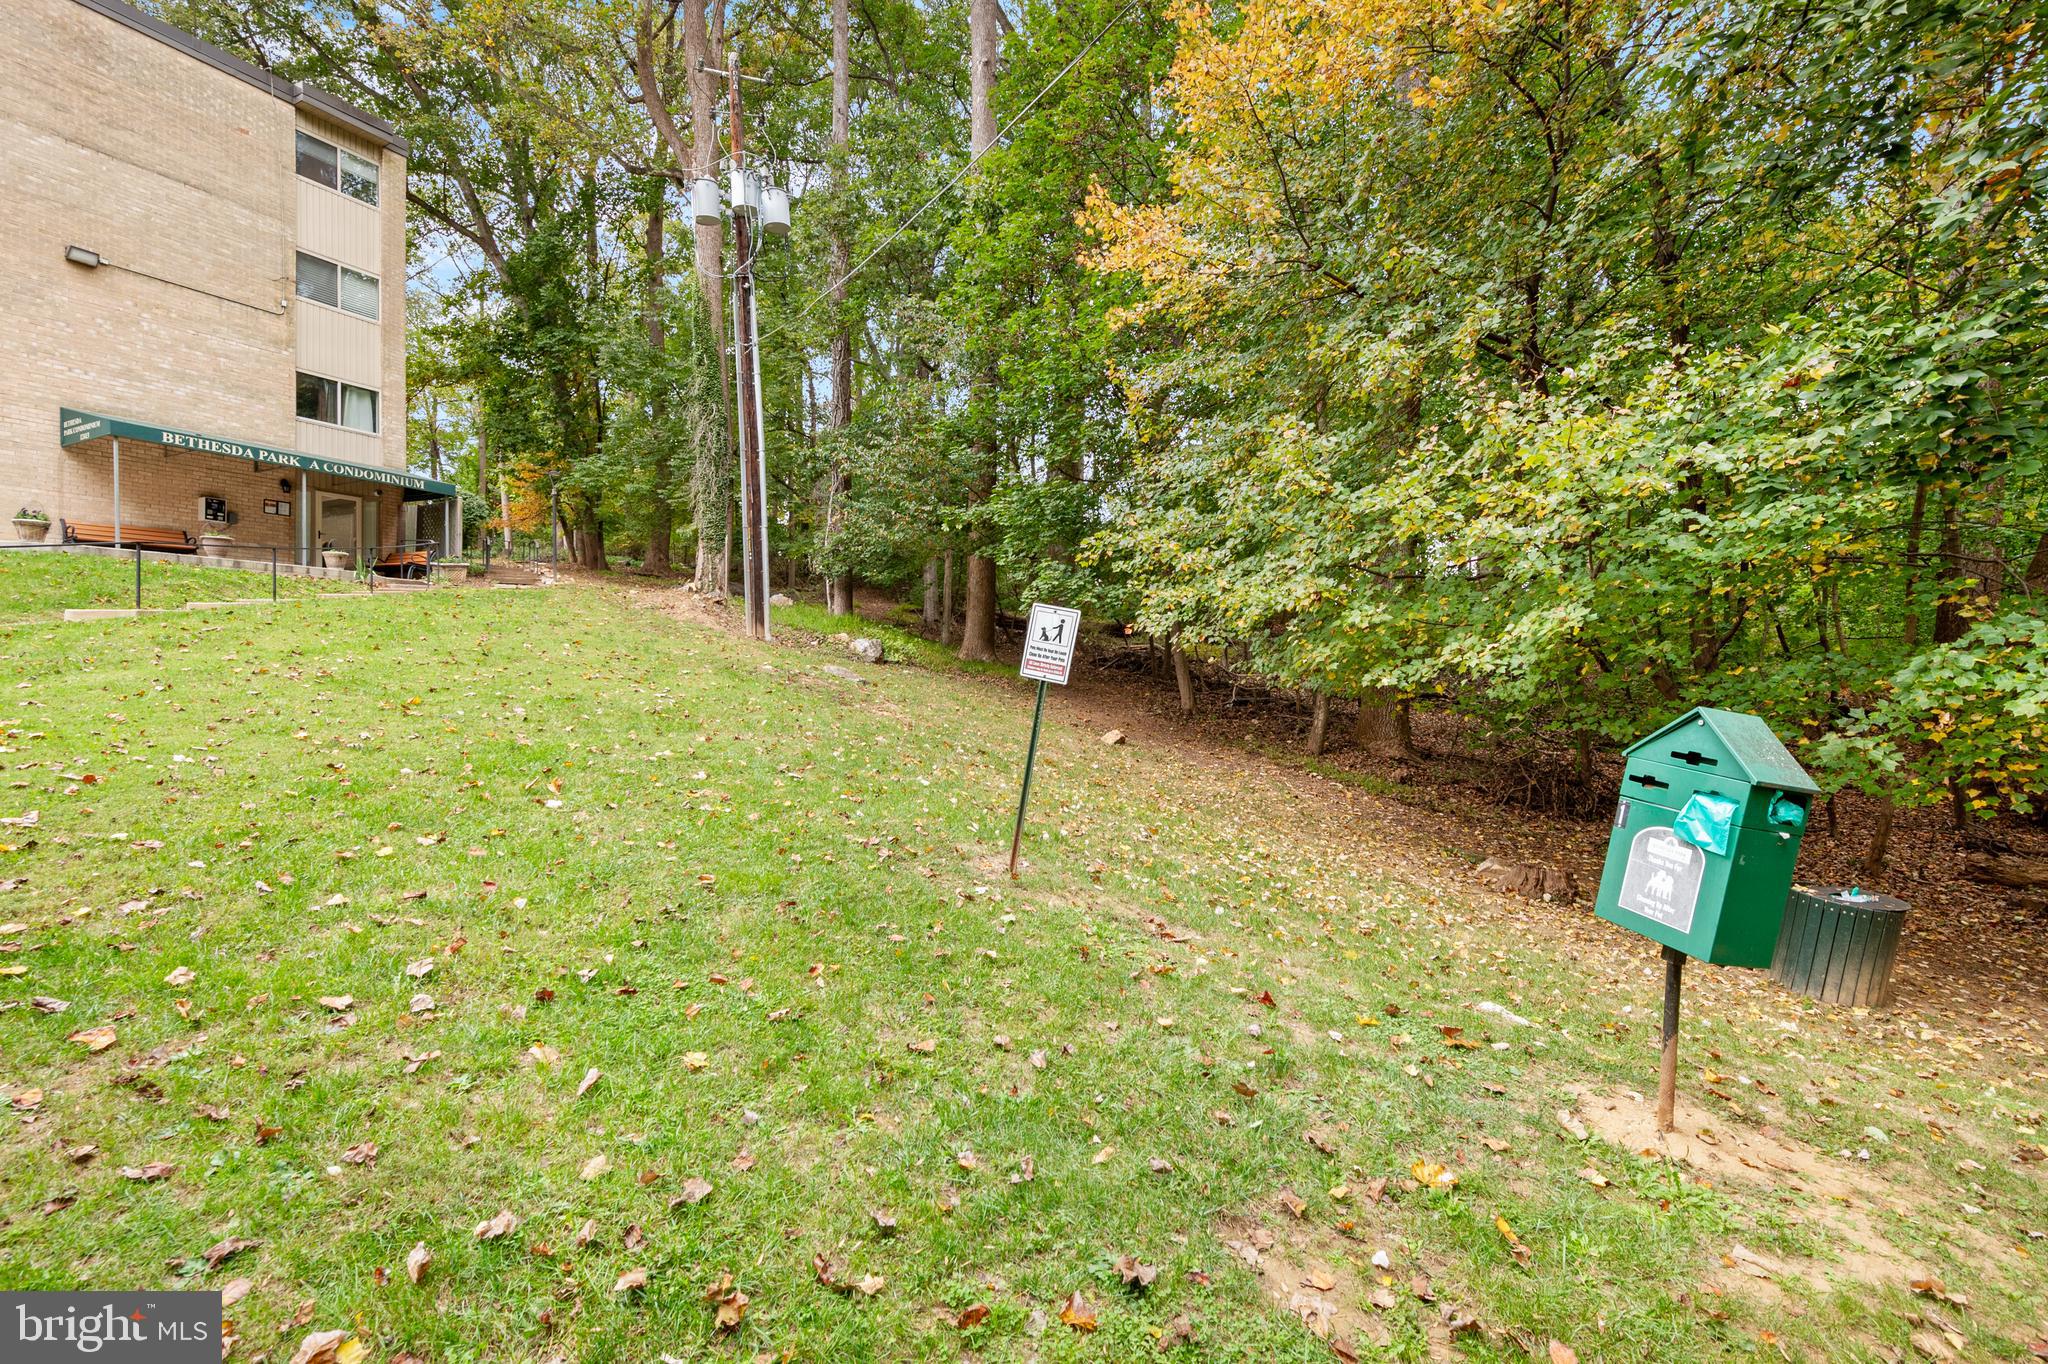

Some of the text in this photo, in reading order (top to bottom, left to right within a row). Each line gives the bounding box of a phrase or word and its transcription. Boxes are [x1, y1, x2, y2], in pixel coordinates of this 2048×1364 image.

[162, 431, 425, 489] BETHESDA PARK A CONDOMINIUM
